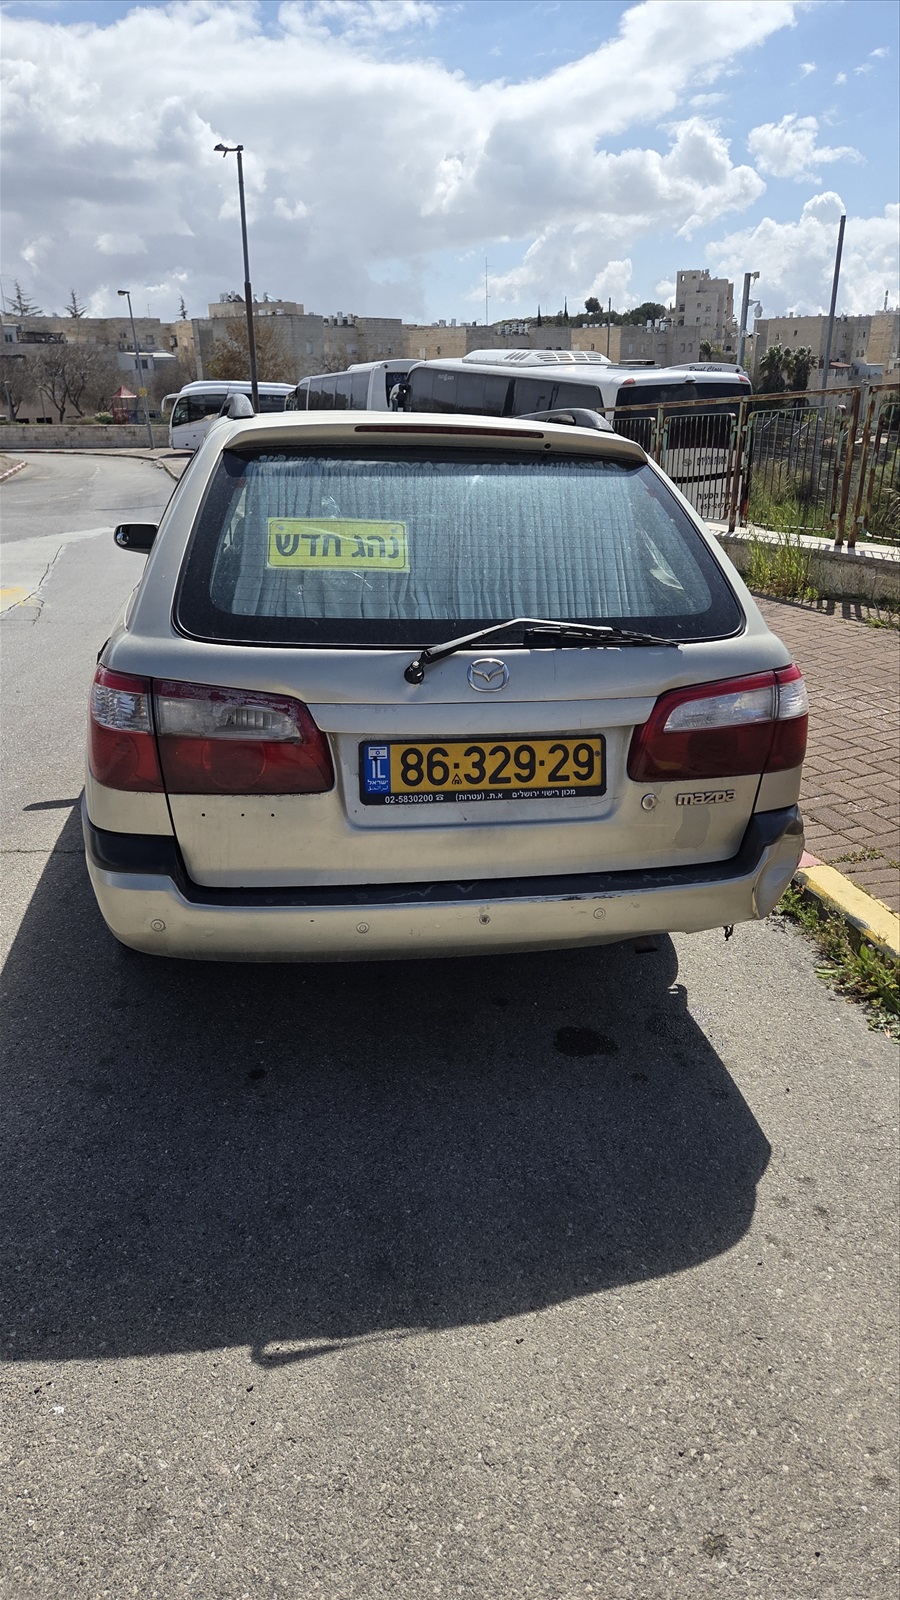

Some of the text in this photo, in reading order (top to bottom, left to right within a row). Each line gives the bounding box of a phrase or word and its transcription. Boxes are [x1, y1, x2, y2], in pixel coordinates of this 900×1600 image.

[275, 533, 400, 558] נהג חדש
[372, 760, 386, 778] IL
[455, 792, 485, 801] (עטרות)
[511, 790, 540, 798] ירושלים
[561, 788, 576, 797] מכון
[384, 794, 434, 804] 02-5830200
